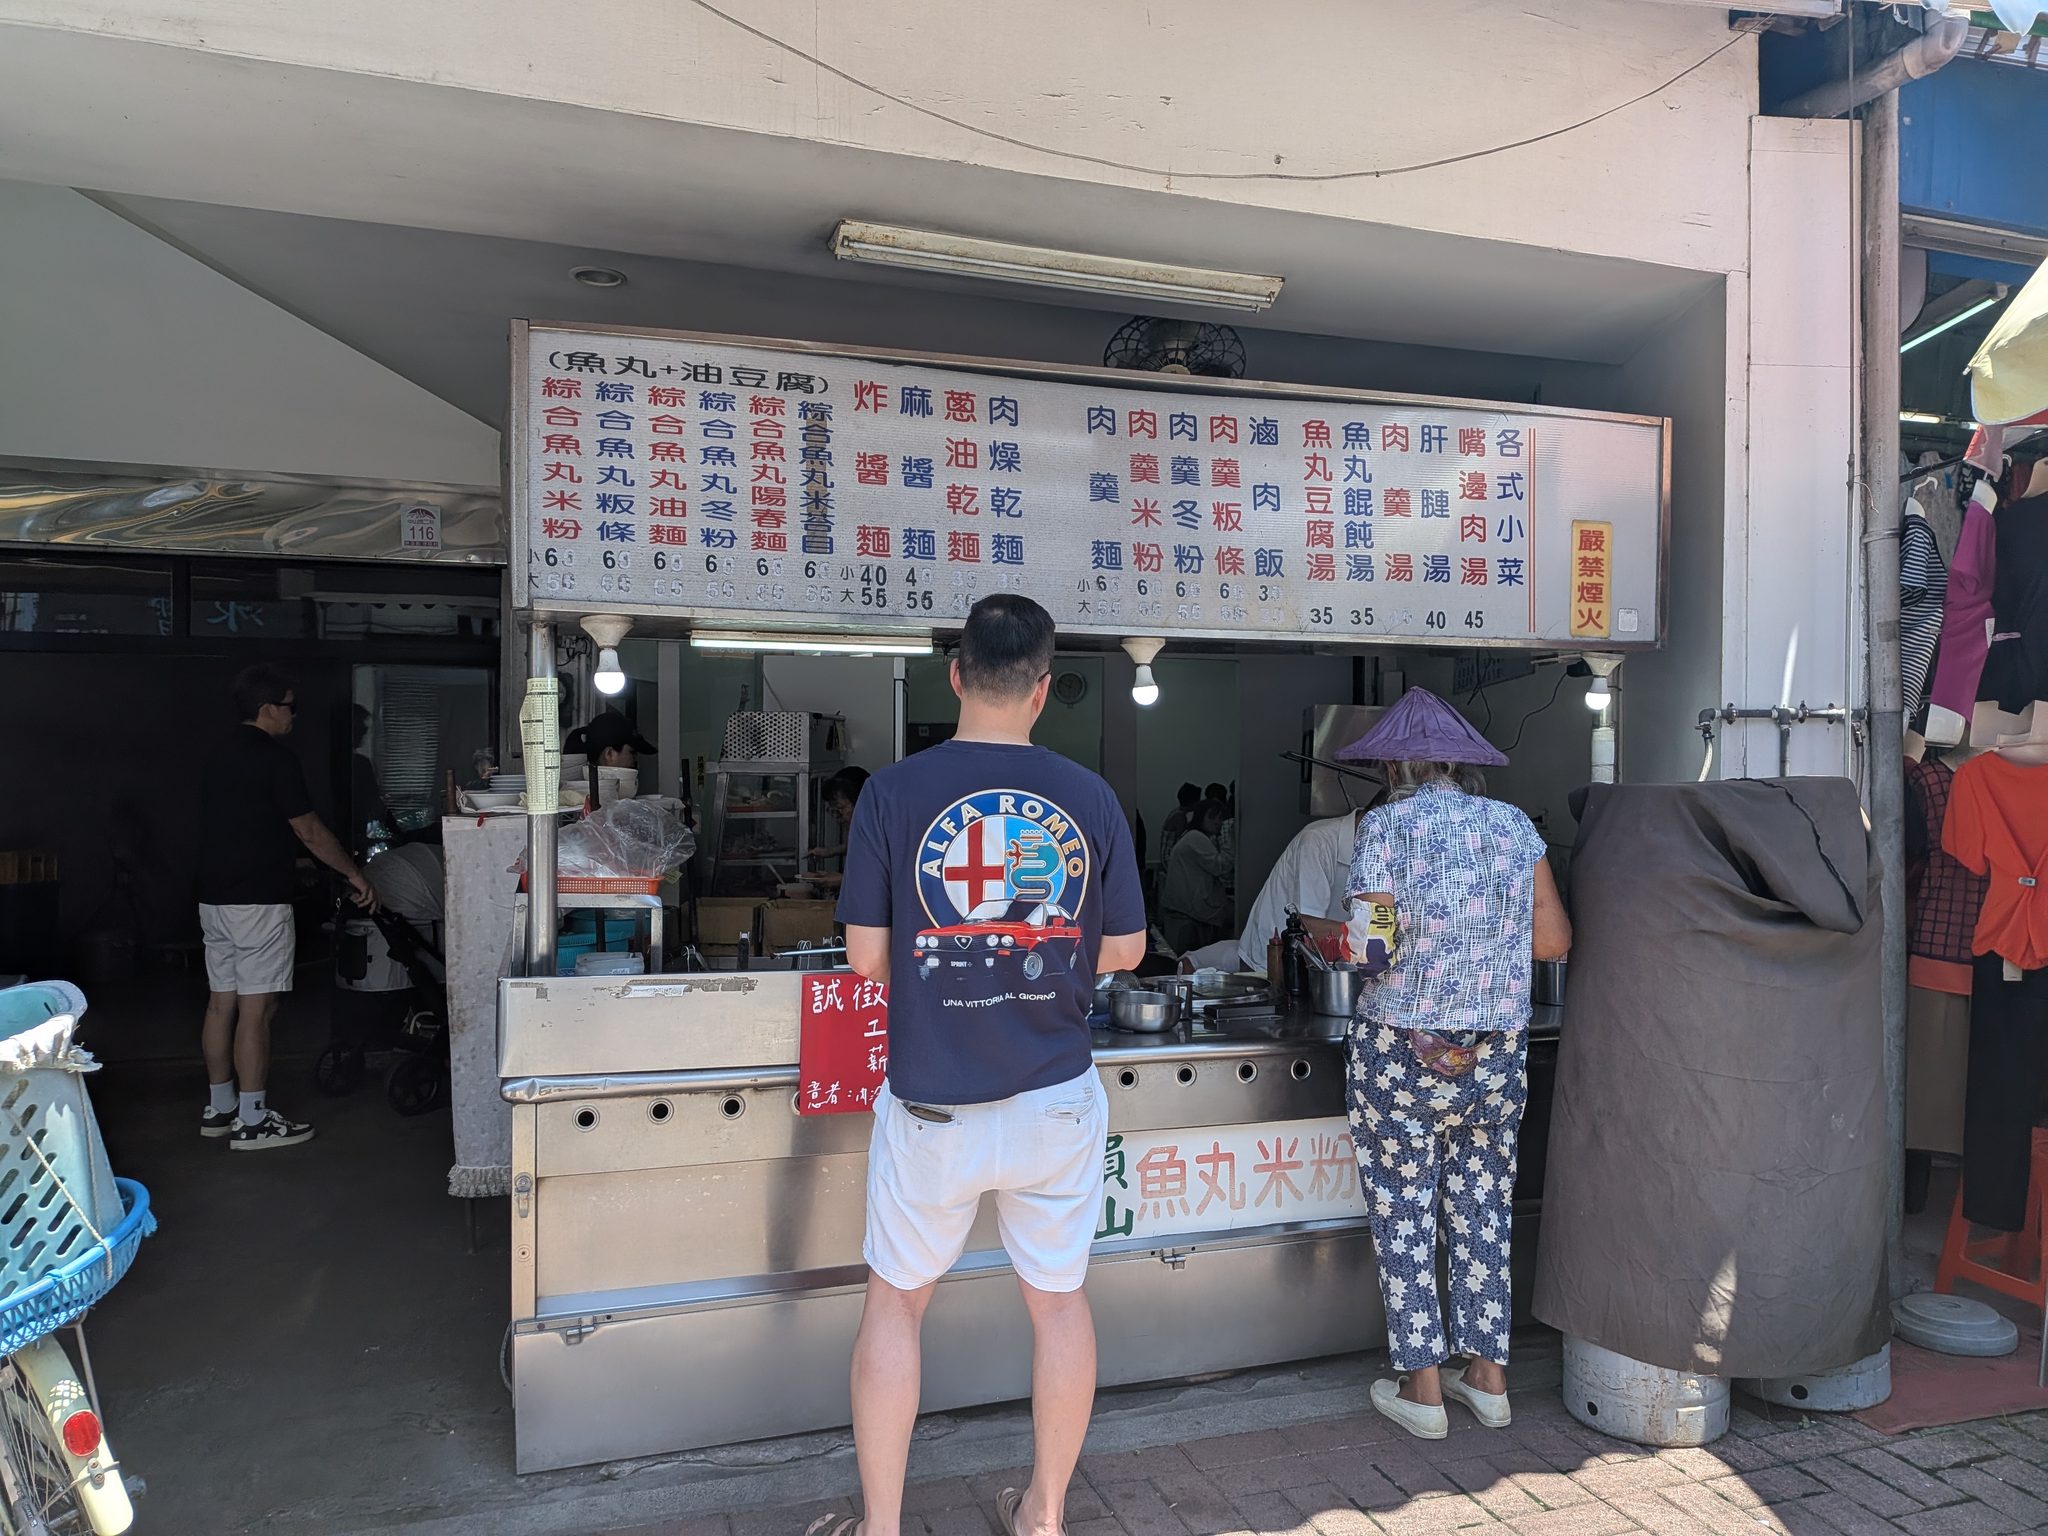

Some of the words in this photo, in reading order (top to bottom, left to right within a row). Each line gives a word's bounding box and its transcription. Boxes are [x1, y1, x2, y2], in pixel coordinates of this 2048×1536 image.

[409, 526, 434, 540] 116
[541, 376, 582, 540] 綜合魚丸米粉
[648, 386, 687, 546] 綜合魚丸油麵
[699, 390, 738, 549] 綜合魚丸冬粉
[749, 395, 788, 552] 綜合魚丸陽春麵
[854, 380, 891, 558] 炸醬麵
[900, 386, 936, 561] 麻醬麵
[989, 395, 1024, 565] 肉燥乾麵
[1249, 417, 1284, 578] 滷肉飯
[1302, 420, 1335, 581] 魚丸豆腐湯
[1342, 422, 1374, 581] 魚丸餛飩湯
[1459, 428, 1487, 585] 嘴邊肉湯
[1496, 429, 1524, 586] 各式小菜
[860, 565, 887, 586] 40
[1310, 607, 1333, 625] 35
[1350, 608, 1374, 625] 35
[1426, 611, 1446, 629] 40
[1465, 611, 1484, 628] 45
[1577, 528, 1605, 630] 嚴禁煙火
[922, 802, 983, 878] ALFA
[999, 794, 1084, 878] ROMEO
[943, 999, 964, 1007] UNA
[965, 995, 1004, 1008] VITTORIA
[1004, 992, 1016, 1000] AL
[1019, 991, 1056, 1001] GIORNO
[1136, 1132, 1357, 1221] 魚丸米粉
